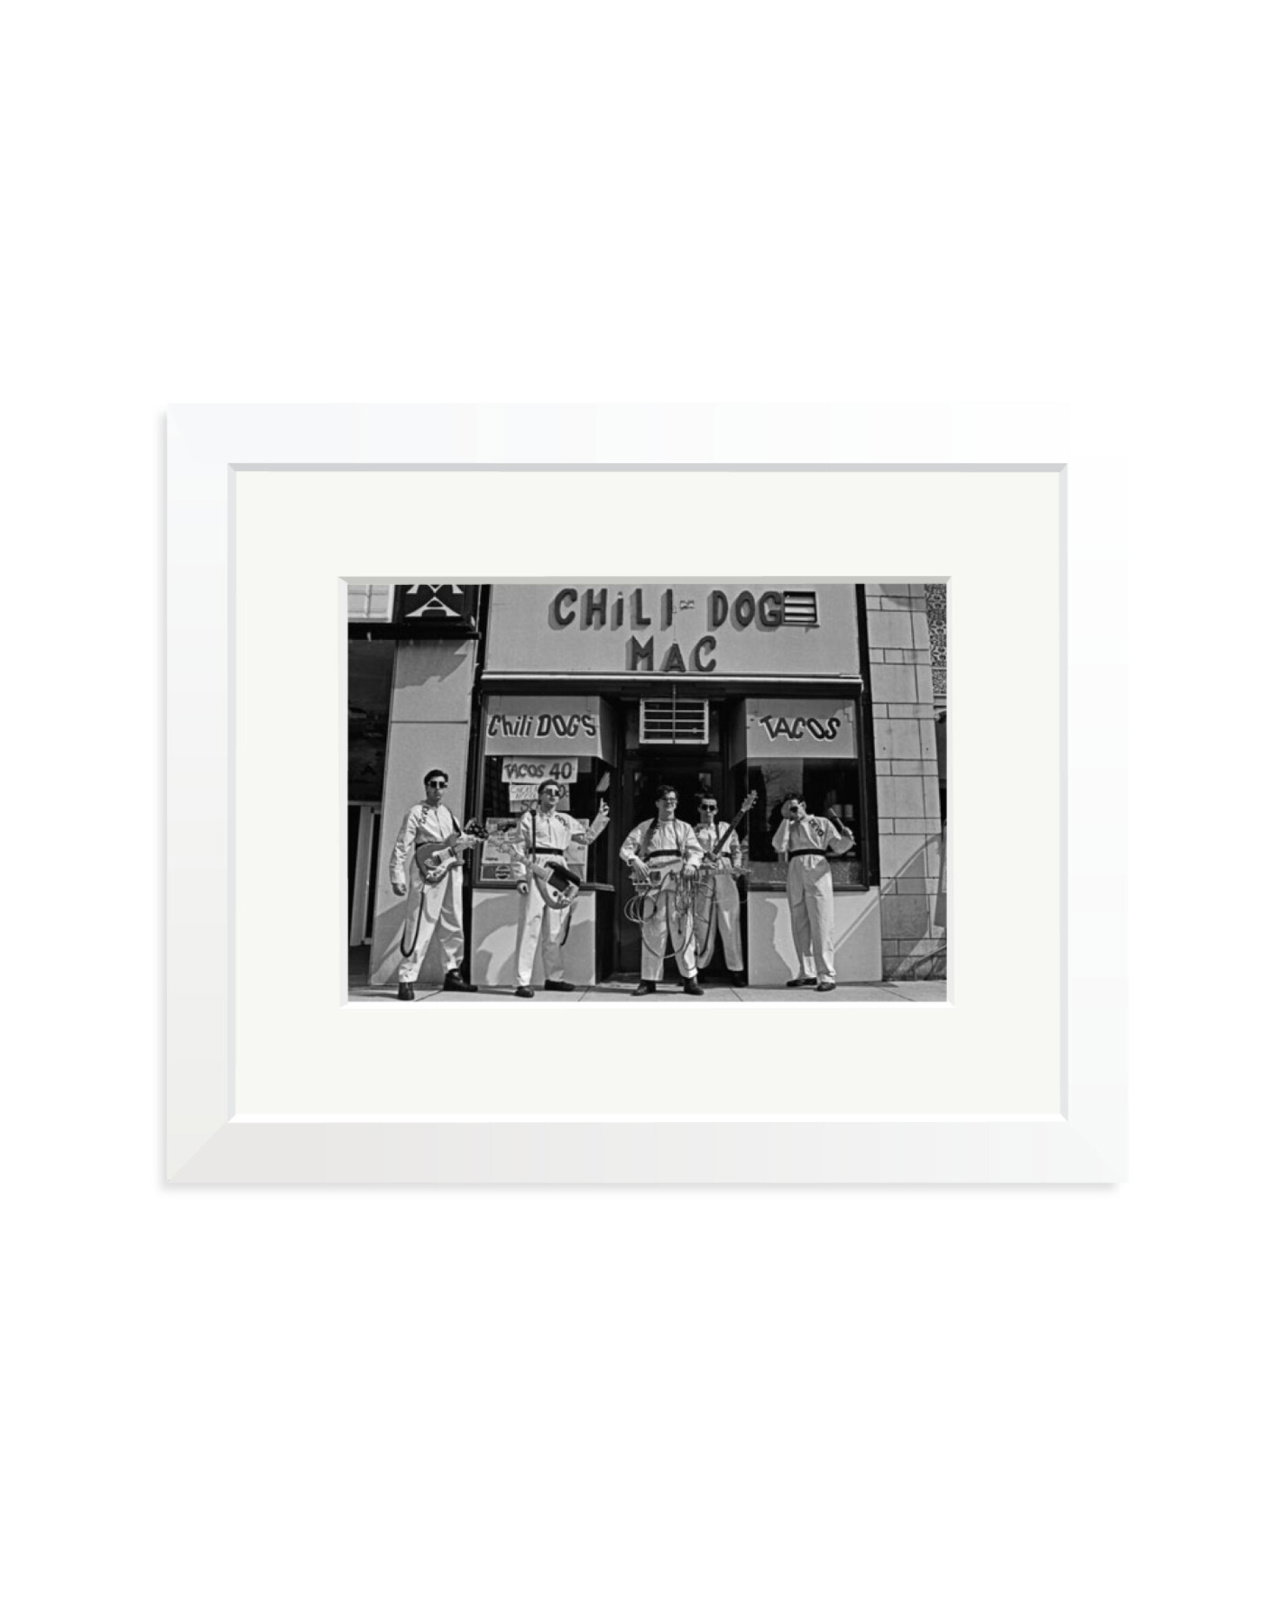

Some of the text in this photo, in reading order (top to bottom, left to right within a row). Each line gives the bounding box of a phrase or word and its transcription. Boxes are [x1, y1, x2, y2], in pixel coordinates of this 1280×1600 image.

[708, 590, 783, 631] DOG
[627, 635, 717, 672] MAC
[487, 714, 596, 738] Chili DOGS
[759, 715, 841, 741] TACOS
[504, 762, 572, 780] TACOS 40
